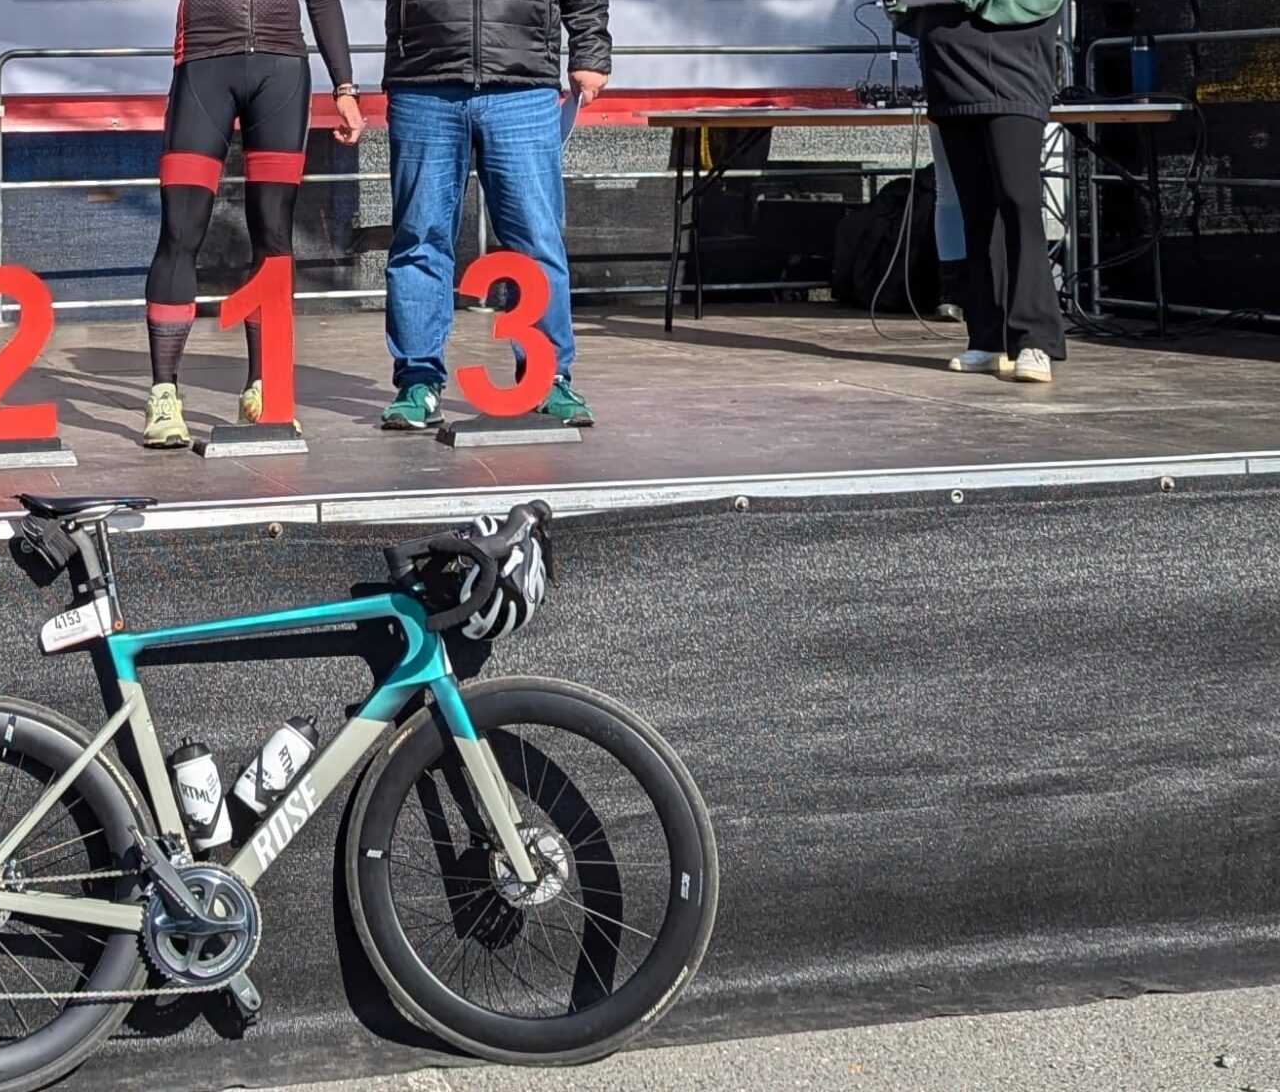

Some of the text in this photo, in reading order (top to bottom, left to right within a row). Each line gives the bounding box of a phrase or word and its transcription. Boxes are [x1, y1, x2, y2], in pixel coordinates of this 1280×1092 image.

[219, 255, 296, 425] 1
[455, 251, 558, 418] 3
[54, 609, 81, 630] 4153
[180, 782, 215, 805] RTML
[251, 773, 322, 871] ROSE
